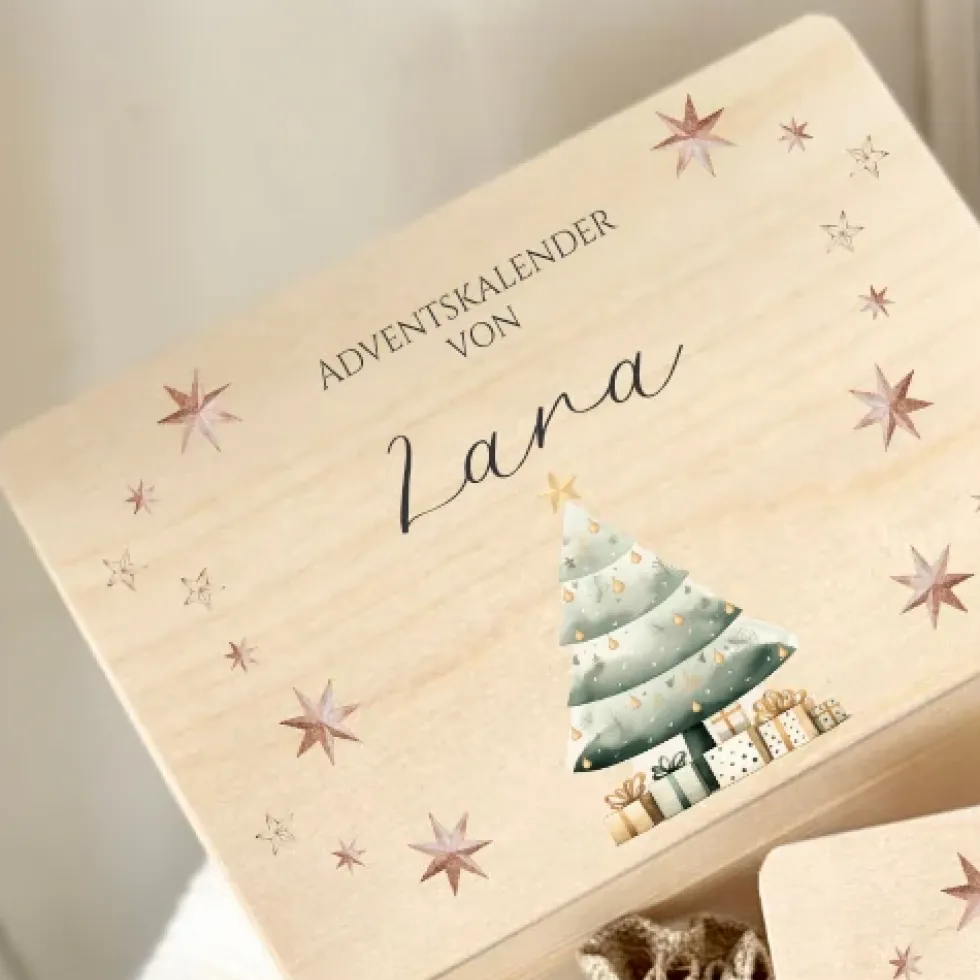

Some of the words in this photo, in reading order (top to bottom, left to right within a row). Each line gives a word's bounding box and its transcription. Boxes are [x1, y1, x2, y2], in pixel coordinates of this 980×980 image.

[319, 209, 617, 390] ADVENTSKALENDER
[446, 305, 522, 358] VON
[387, 344, 684, 534] Lara
